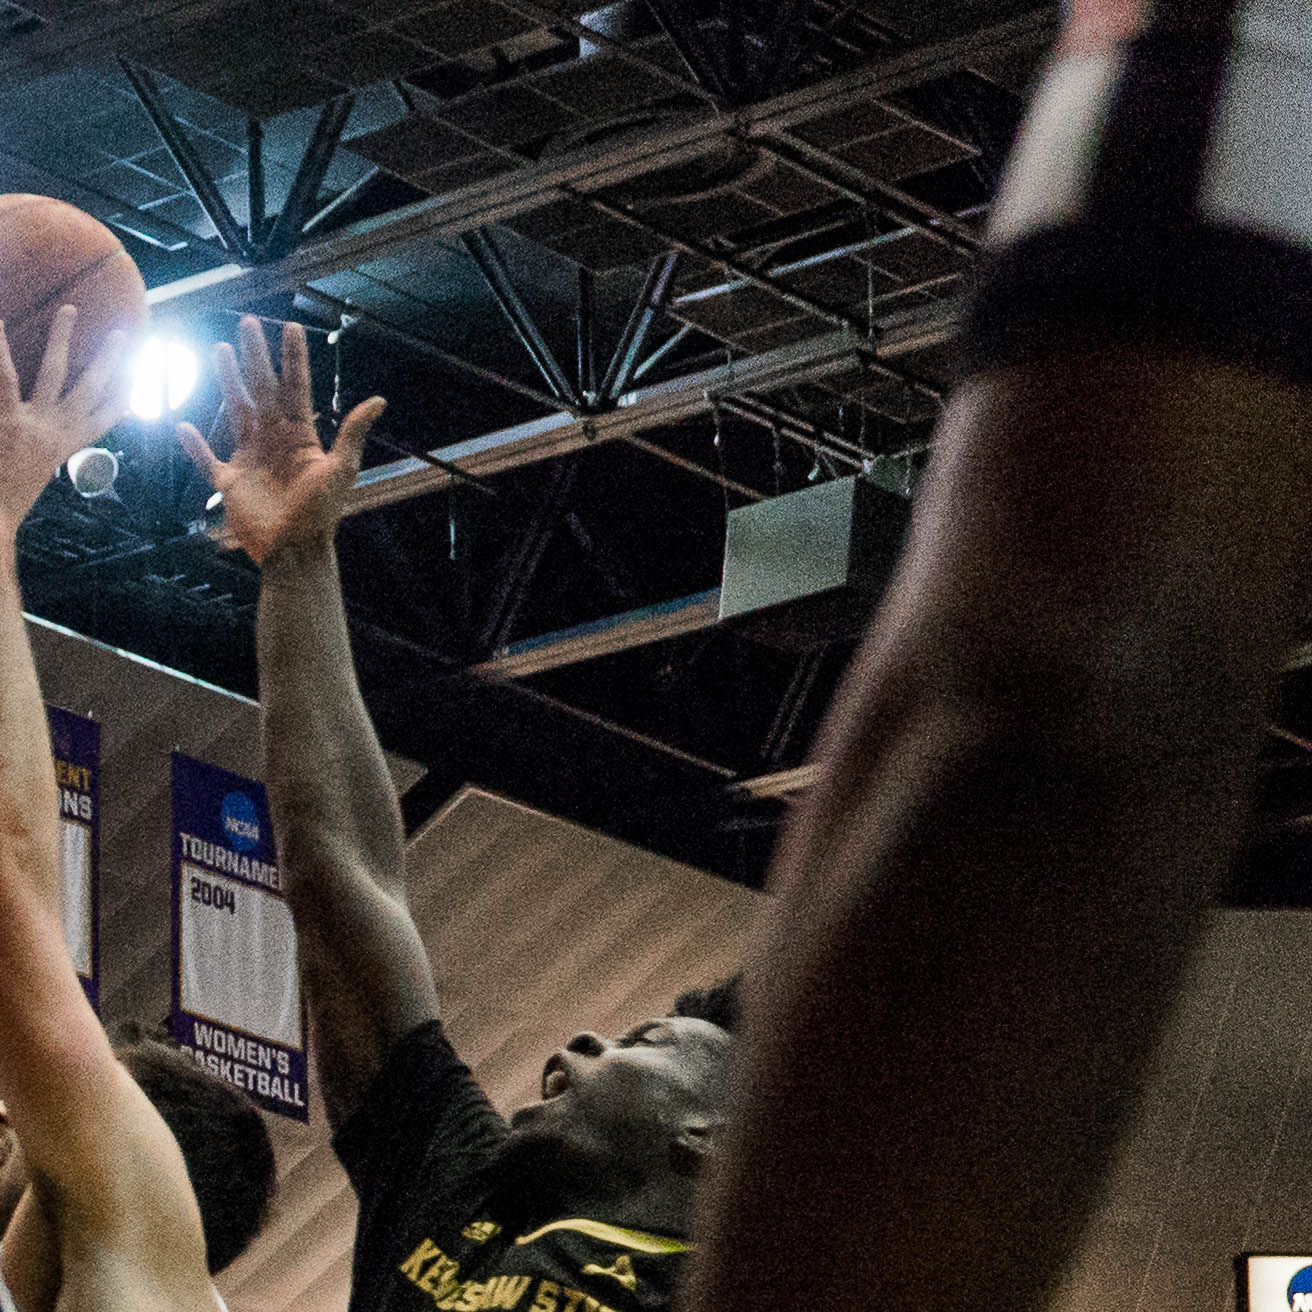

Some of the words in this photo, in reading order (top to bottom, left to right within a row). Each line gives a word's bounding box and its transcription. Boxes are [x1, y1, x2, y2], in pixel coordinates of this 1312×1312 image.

[180, 832, 279, 889] TOURNAME
[191, 876, 236, 915] 2004
[194, 1021, 290, 1073] WOMEN'S
